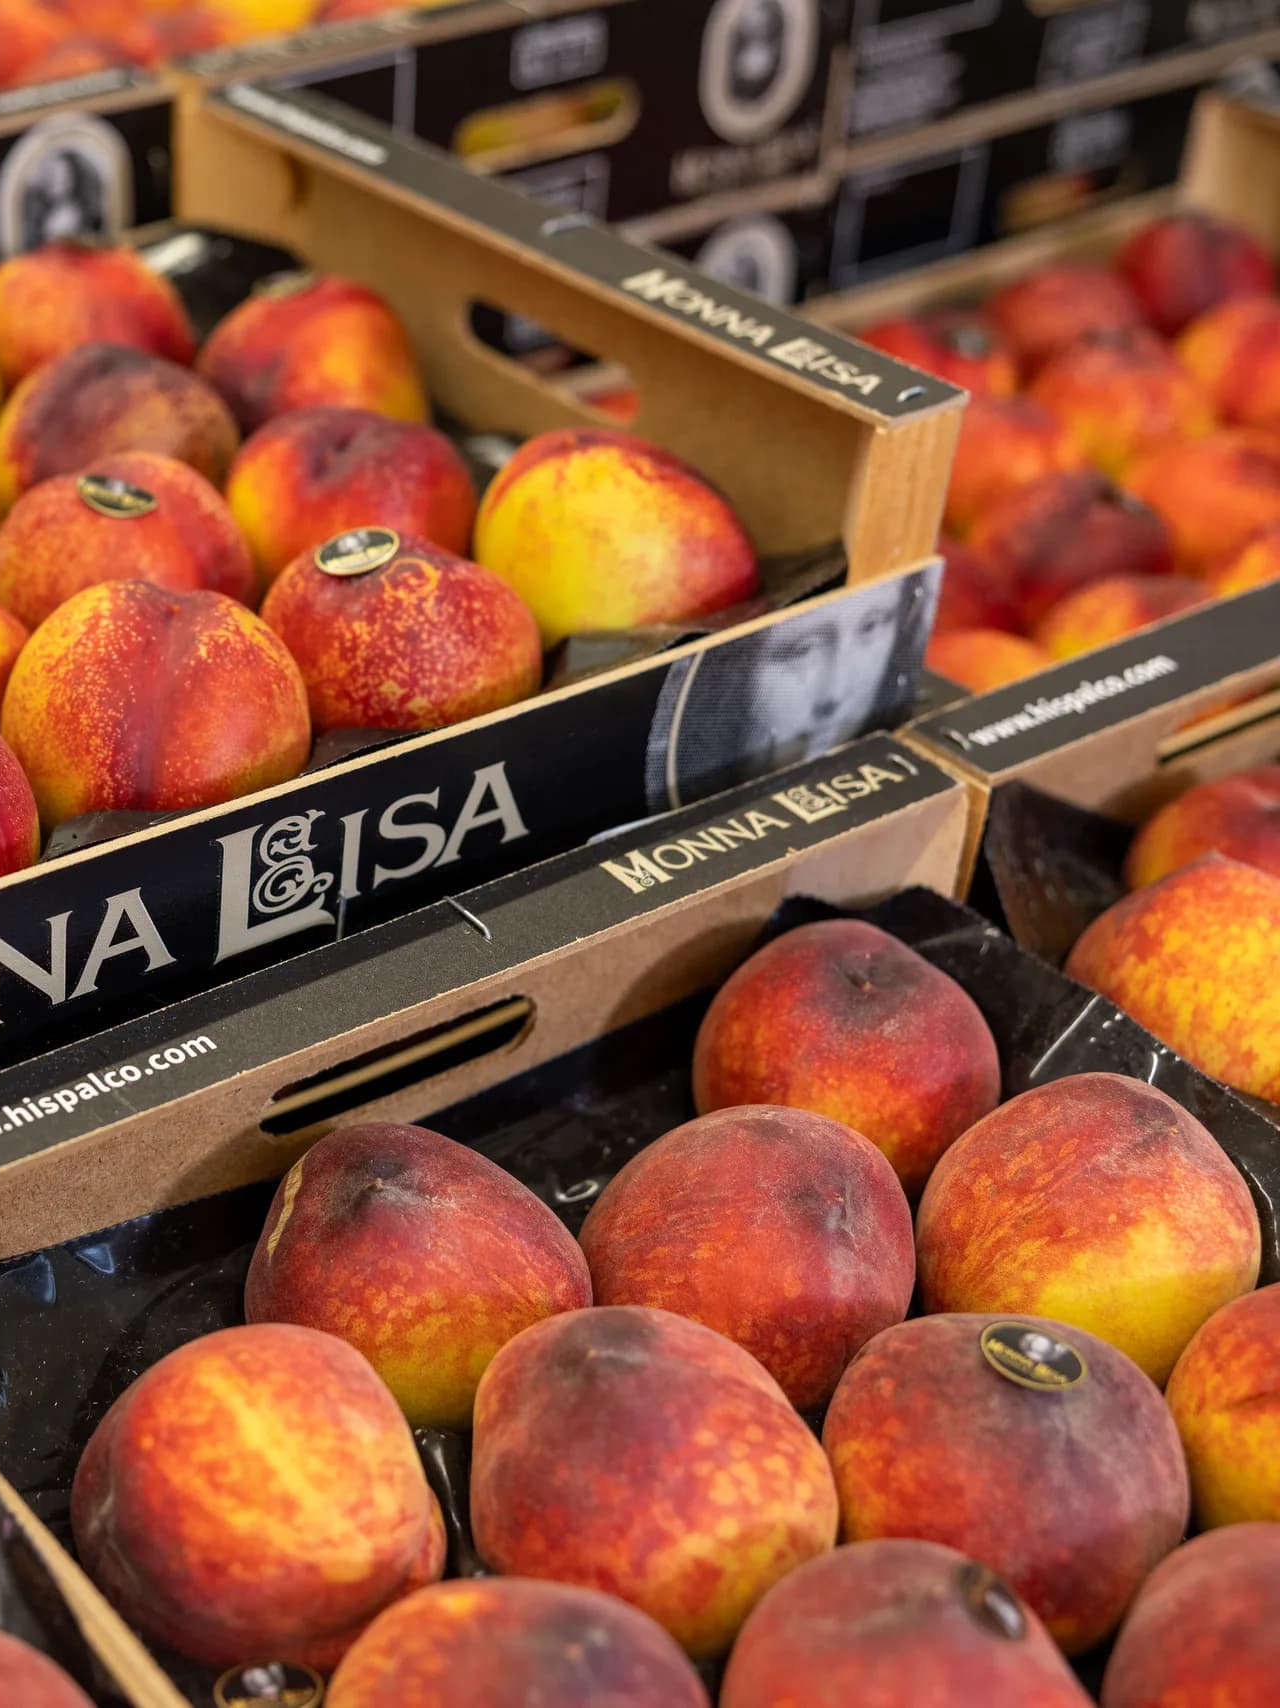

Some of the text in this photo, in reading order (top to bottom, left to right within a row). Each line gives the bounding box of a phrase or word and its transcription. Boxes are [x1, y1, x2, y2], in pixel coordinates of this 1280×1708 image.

[621, 268, 883, 396] MONNA LISA
[968, 655, 1179, 747] www.hispalco.com
[212, 761, 530, 965] LISA
[599, 763, 906, 895] MONNA LISA
